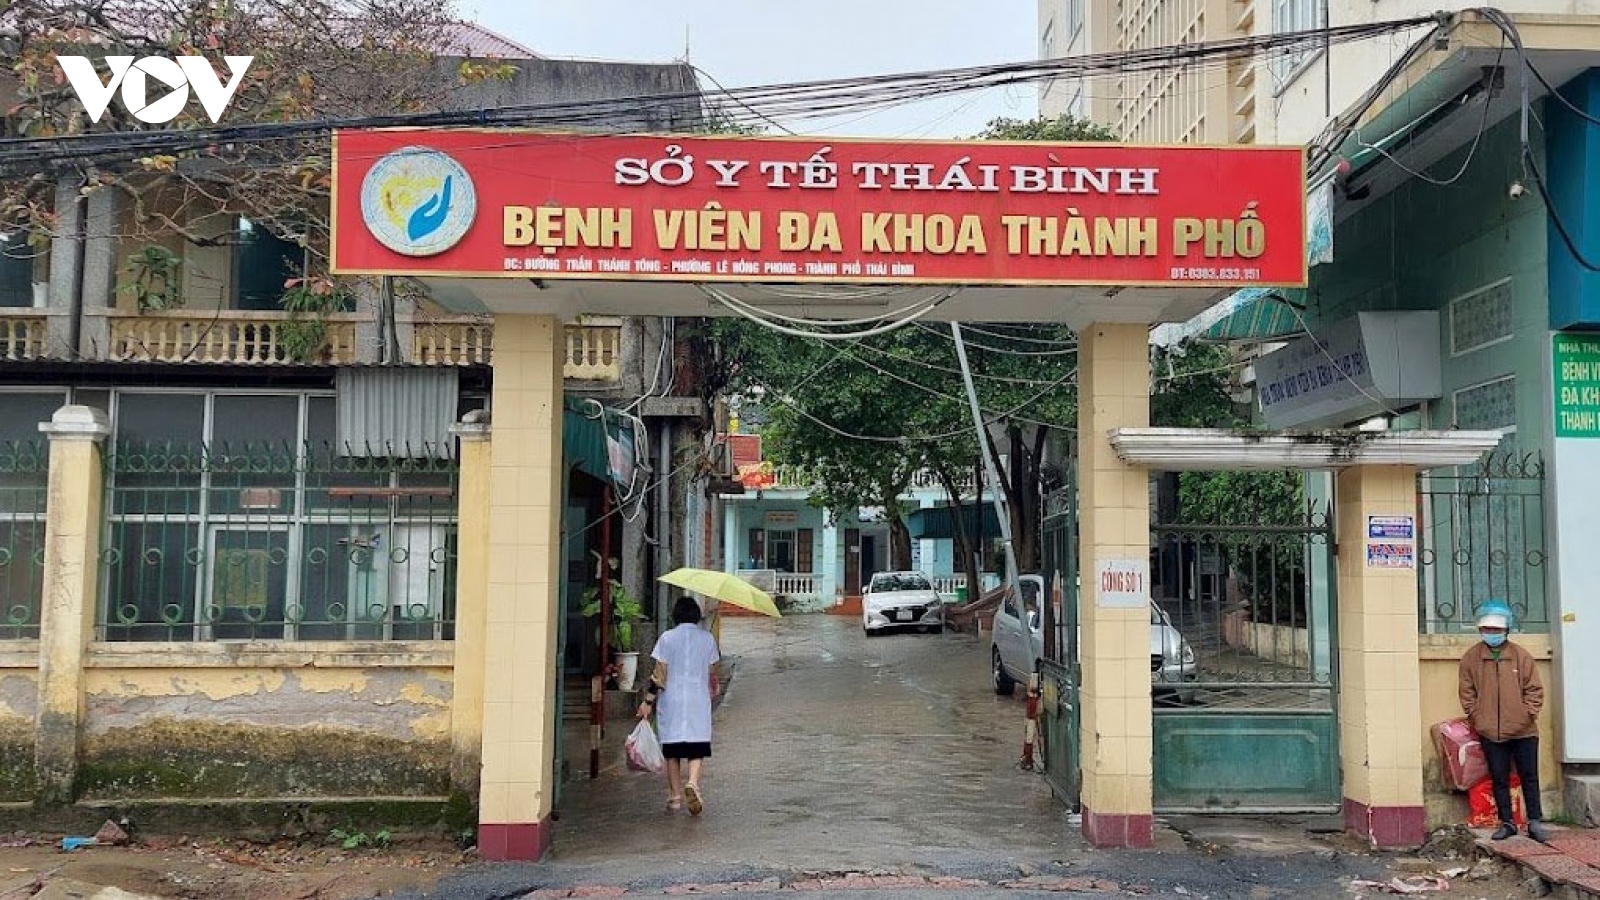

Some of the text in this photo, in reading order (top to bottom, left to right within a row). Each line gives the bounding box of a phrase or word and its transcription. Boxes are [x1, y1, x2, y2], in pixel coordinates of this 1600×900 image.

[615, 145, 1159, 194] SỞ Y TẾ THÁI BÌNH
[777, 211, 842, 252] ĐA
[861, 212, 987, 253] KHOA
[1001, 207, 1157, 256] THÀNH
[1173, 201, 1265, 257] PHỐ
[764, 262, 796, 274] PHONG
[1138, 572, 1143, 593] 1
